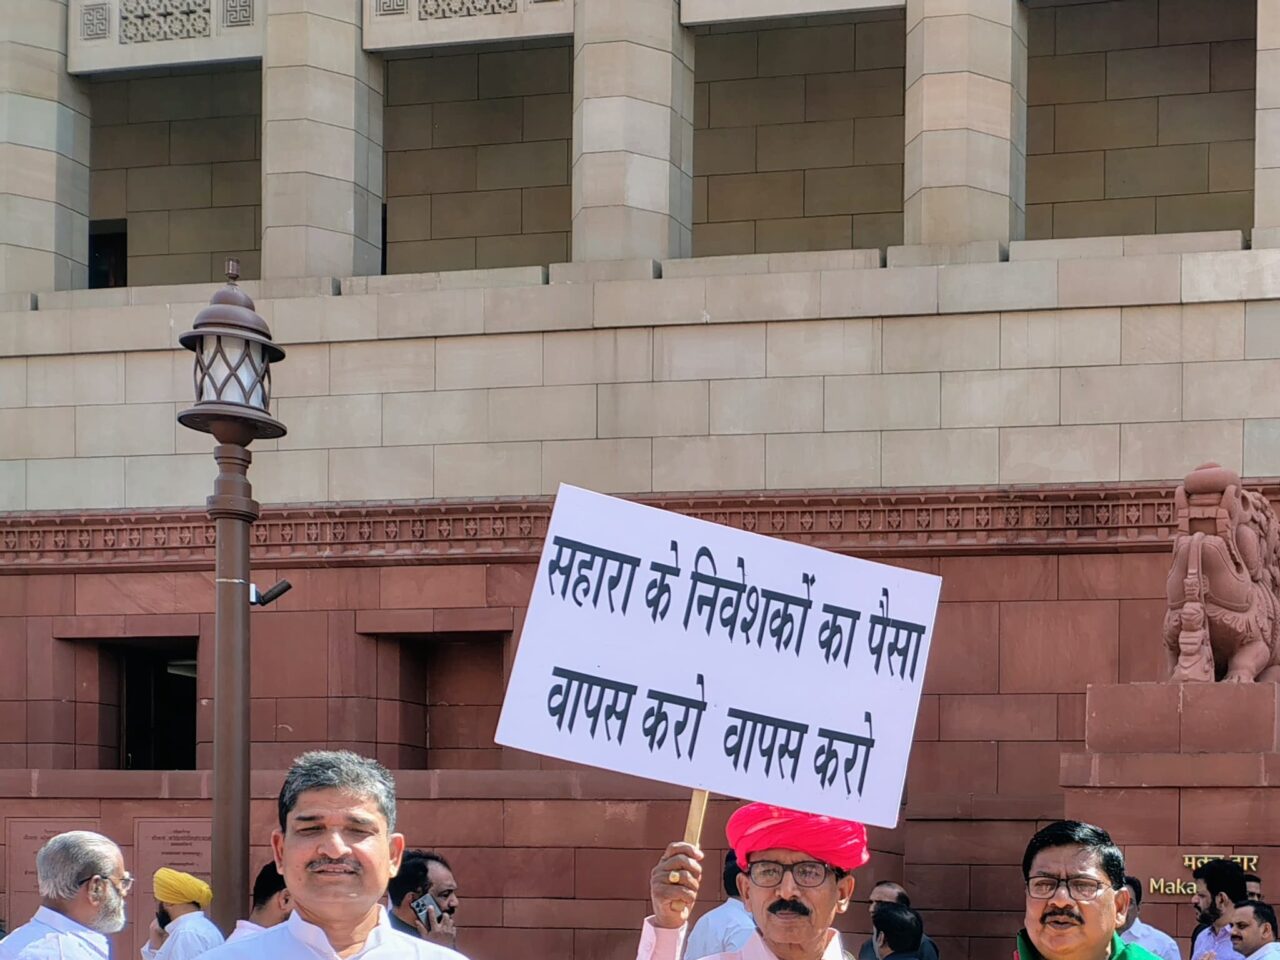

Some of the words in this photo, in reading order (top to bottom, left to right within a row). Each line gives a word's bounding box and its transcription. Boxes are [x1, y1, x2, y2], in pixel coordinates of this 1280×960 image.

[548, 535, 641, 616] सहारा
[646, 540, 679, 623] के
[683, 546, 816, 657] निवेशकों
[818, 603, 861, 668] का
[868, 588, 926, 683] पैसा
[547, 666, 637, 745] वापस
[642, 674, 708, 762] करो
[723, 707, 808, 783] वापस
[813, 712, 875, 798] करो
[1149, 877, 1197, 895] Maka
